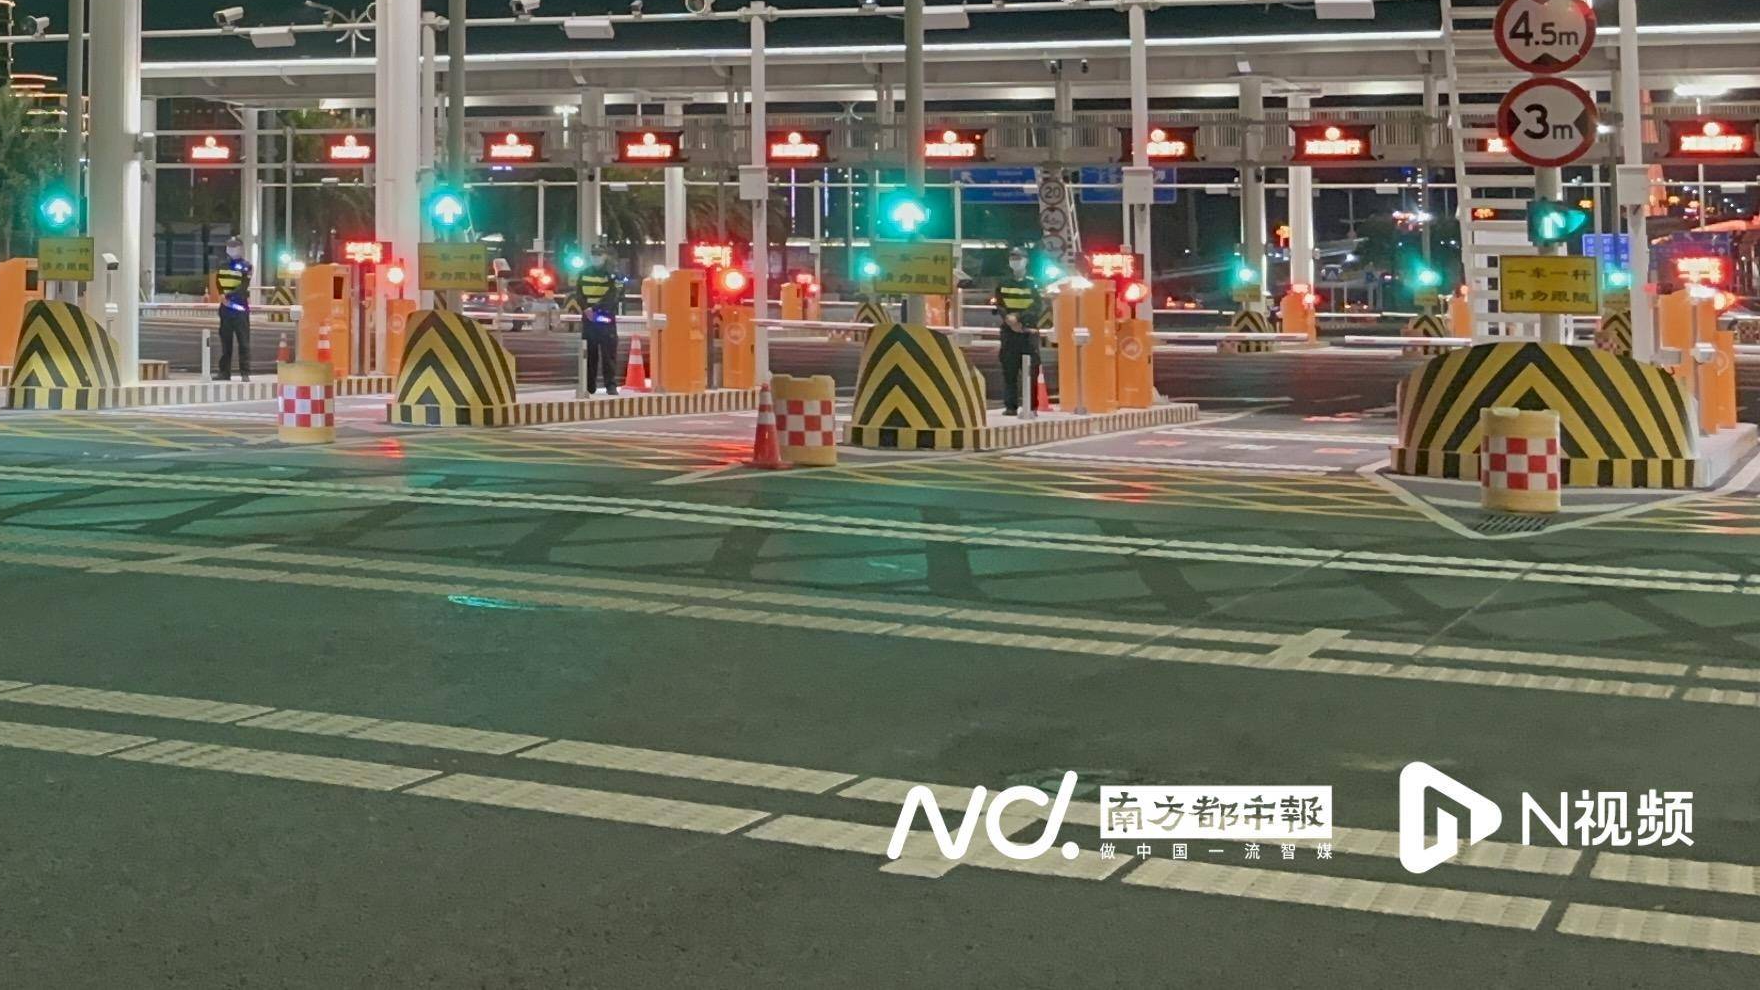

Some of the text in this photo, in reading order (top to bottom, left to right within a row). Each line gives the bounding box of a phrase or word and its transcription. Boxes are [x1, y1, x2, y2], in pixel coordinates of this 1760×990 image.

[1508, 10, 1580, 48] 4.5m
[1523, 103, 1574, 141] 3m
[1506, 267, 1592, 281] 一车一杆
